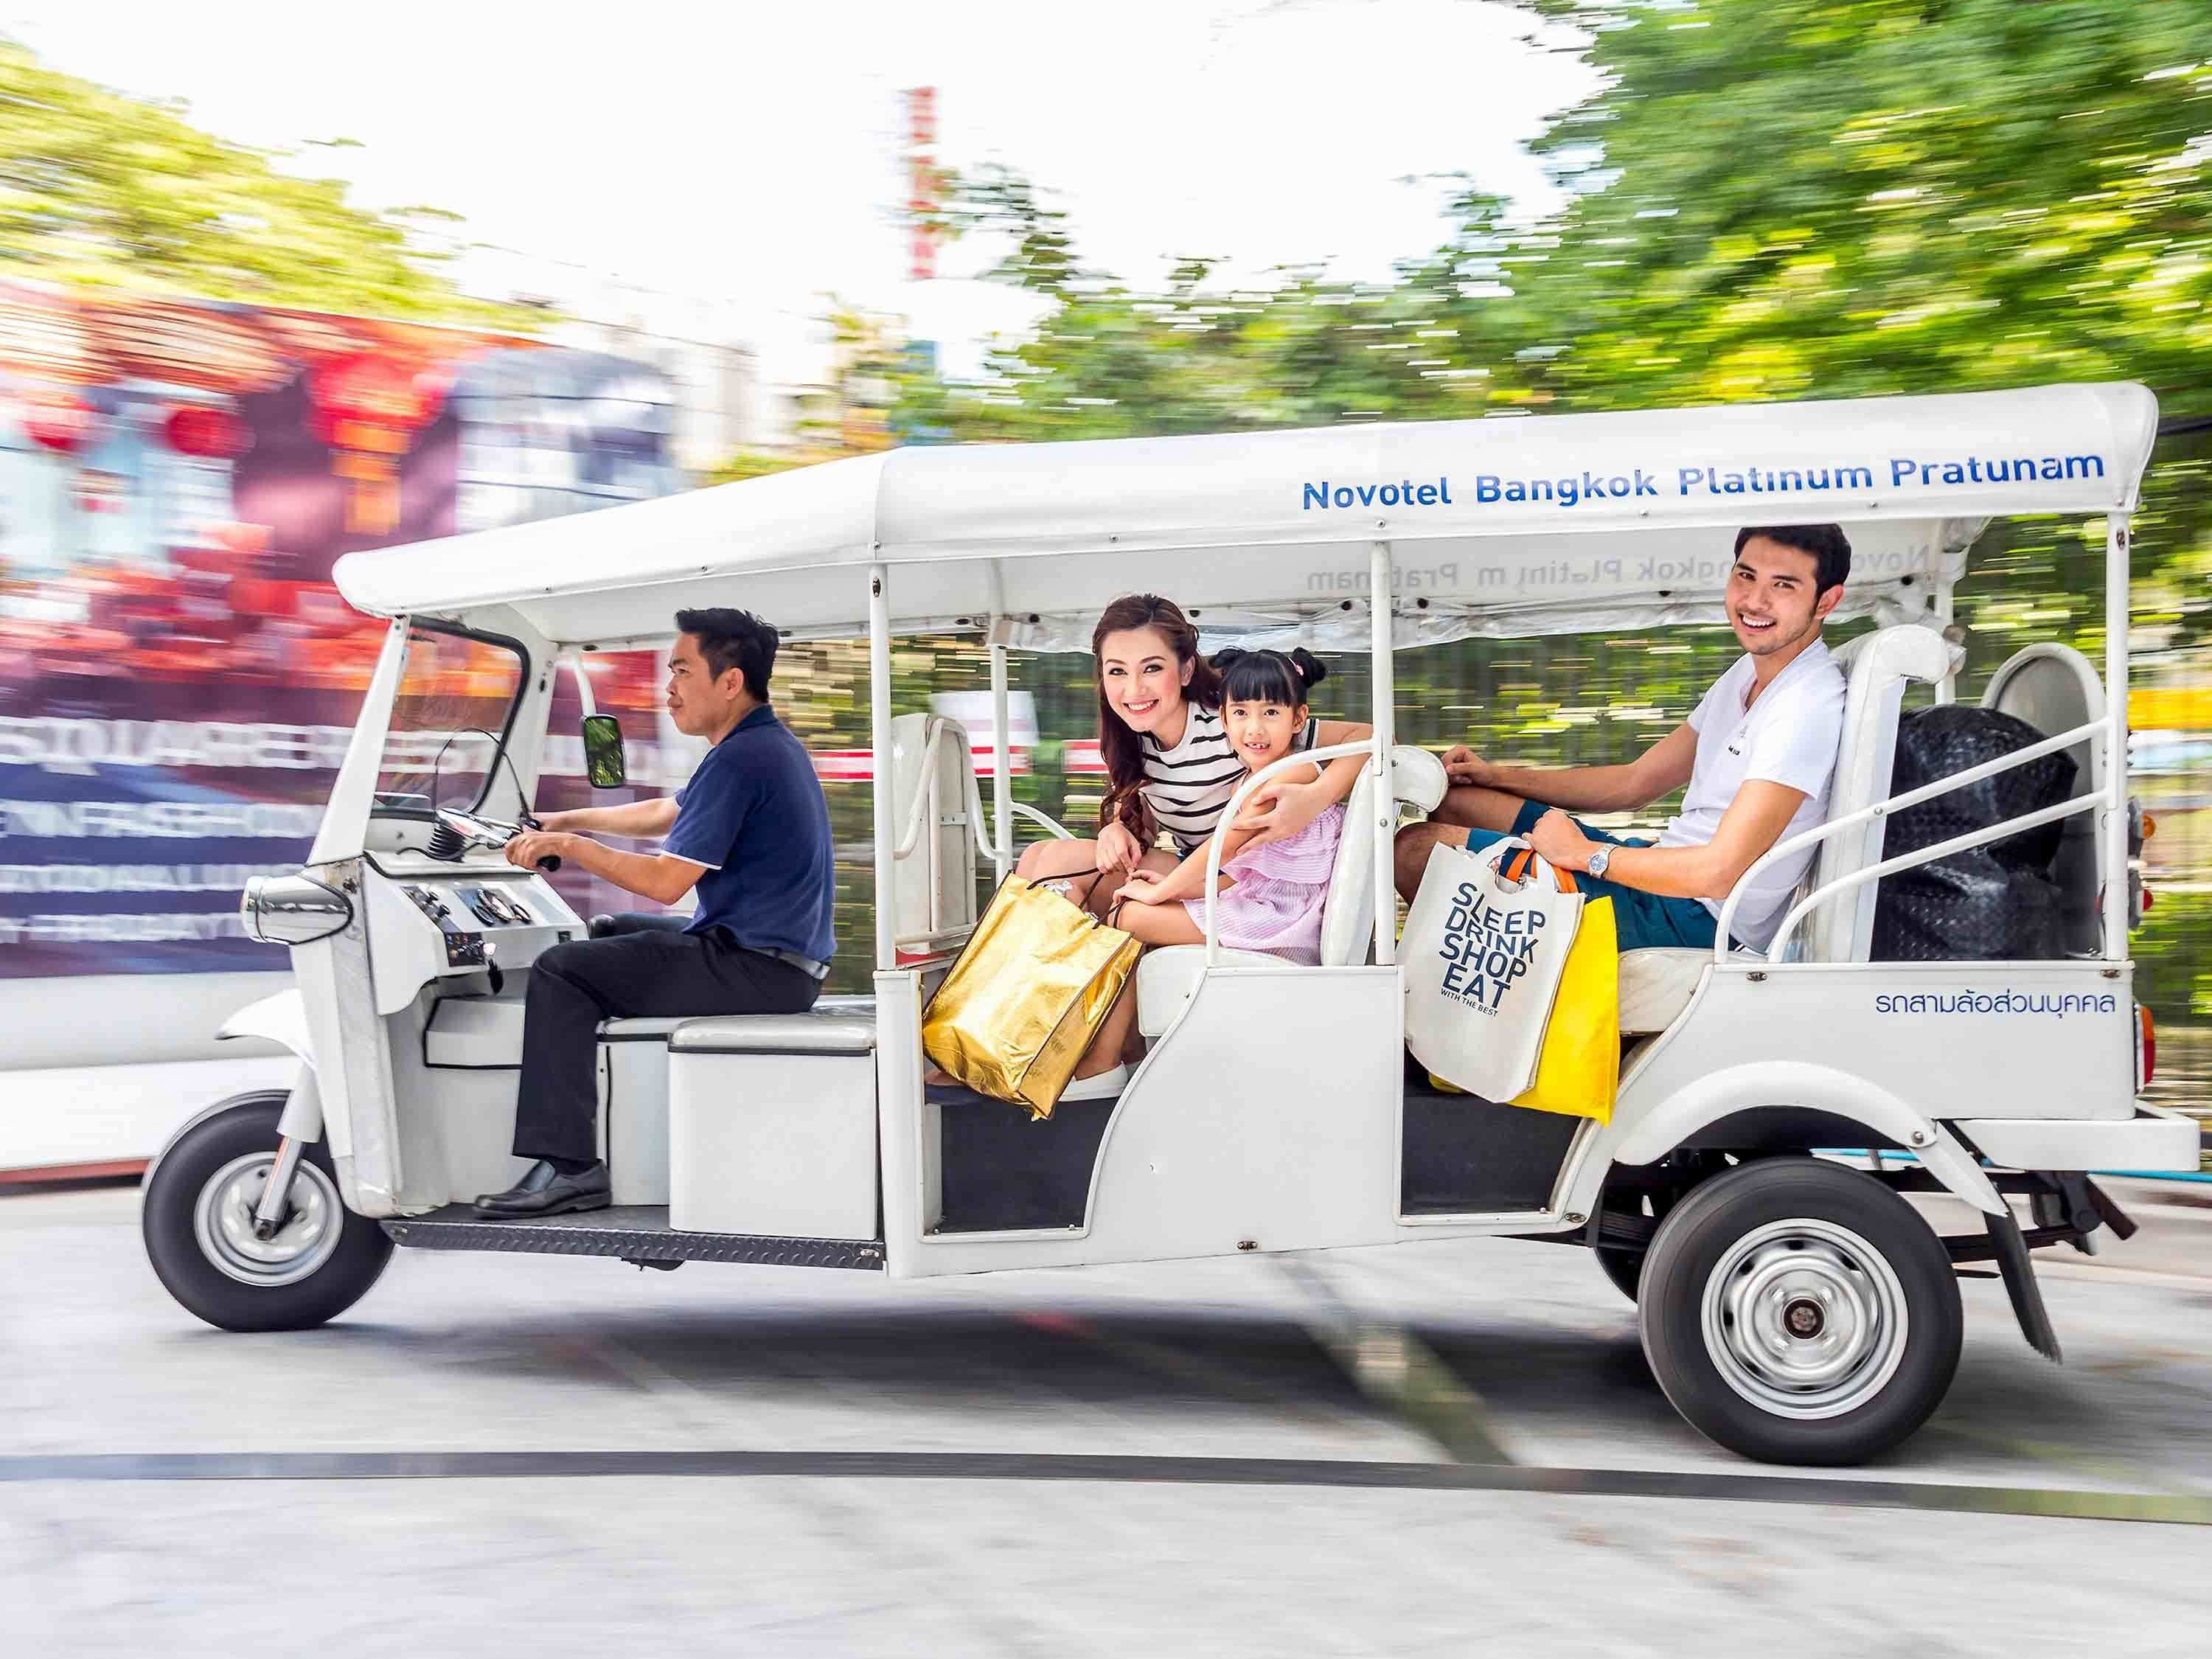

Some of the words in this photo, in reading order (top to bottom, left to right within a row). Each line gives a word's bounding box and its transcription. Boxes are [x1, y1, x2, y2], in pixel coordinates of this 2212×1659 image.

[1303, 476, 1452, 510] Novotel
[1475, 470, 1658, 507] Bangkok
[1679, 466, 1874, 495] Platinum
[1890, 454, 2105, 487] Pratunam
[1452, 882, 1546, 935] SLEEP
[1439, 933, 1527, 984] SHOP
[1445, 906, 1540, 964] DRINK
[1441, 988, 1461, 1002] WITH
[1462, 997, 1477, 1009] THE
[1478, 1004, 1498, 1018] BEST
[1442, 962, 1511, 1009] EAT
[1875, 988, 2116, 1018] รถสามล้อส่วนบุคคล
